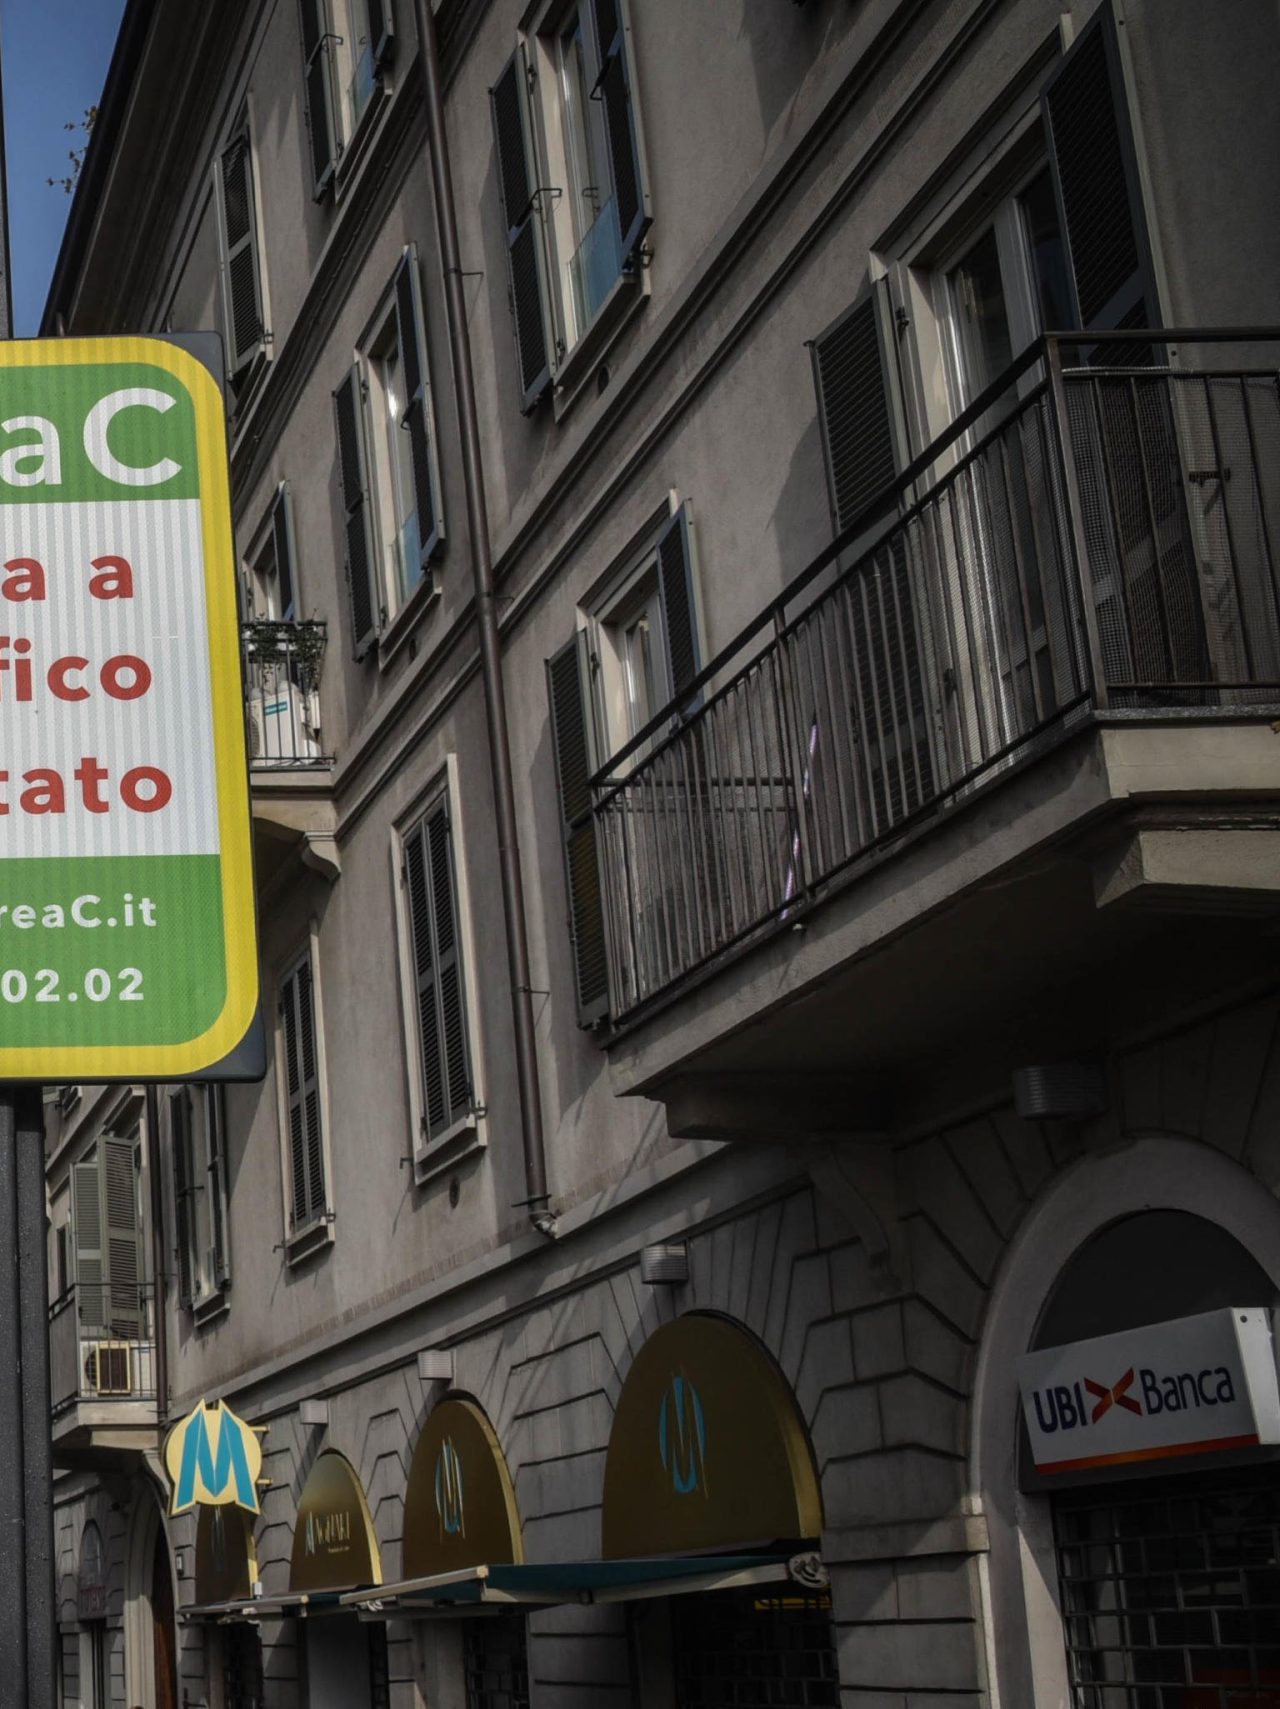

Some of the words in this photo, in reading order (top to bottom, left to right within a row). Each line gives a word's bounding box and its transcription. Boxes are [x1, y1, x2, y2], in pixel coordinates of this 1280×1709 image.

[88, 555, 133, 599] a
[1032, 1381, 1088, 1433] UBI
[1139, 1365, 1235, 1416] Banca
